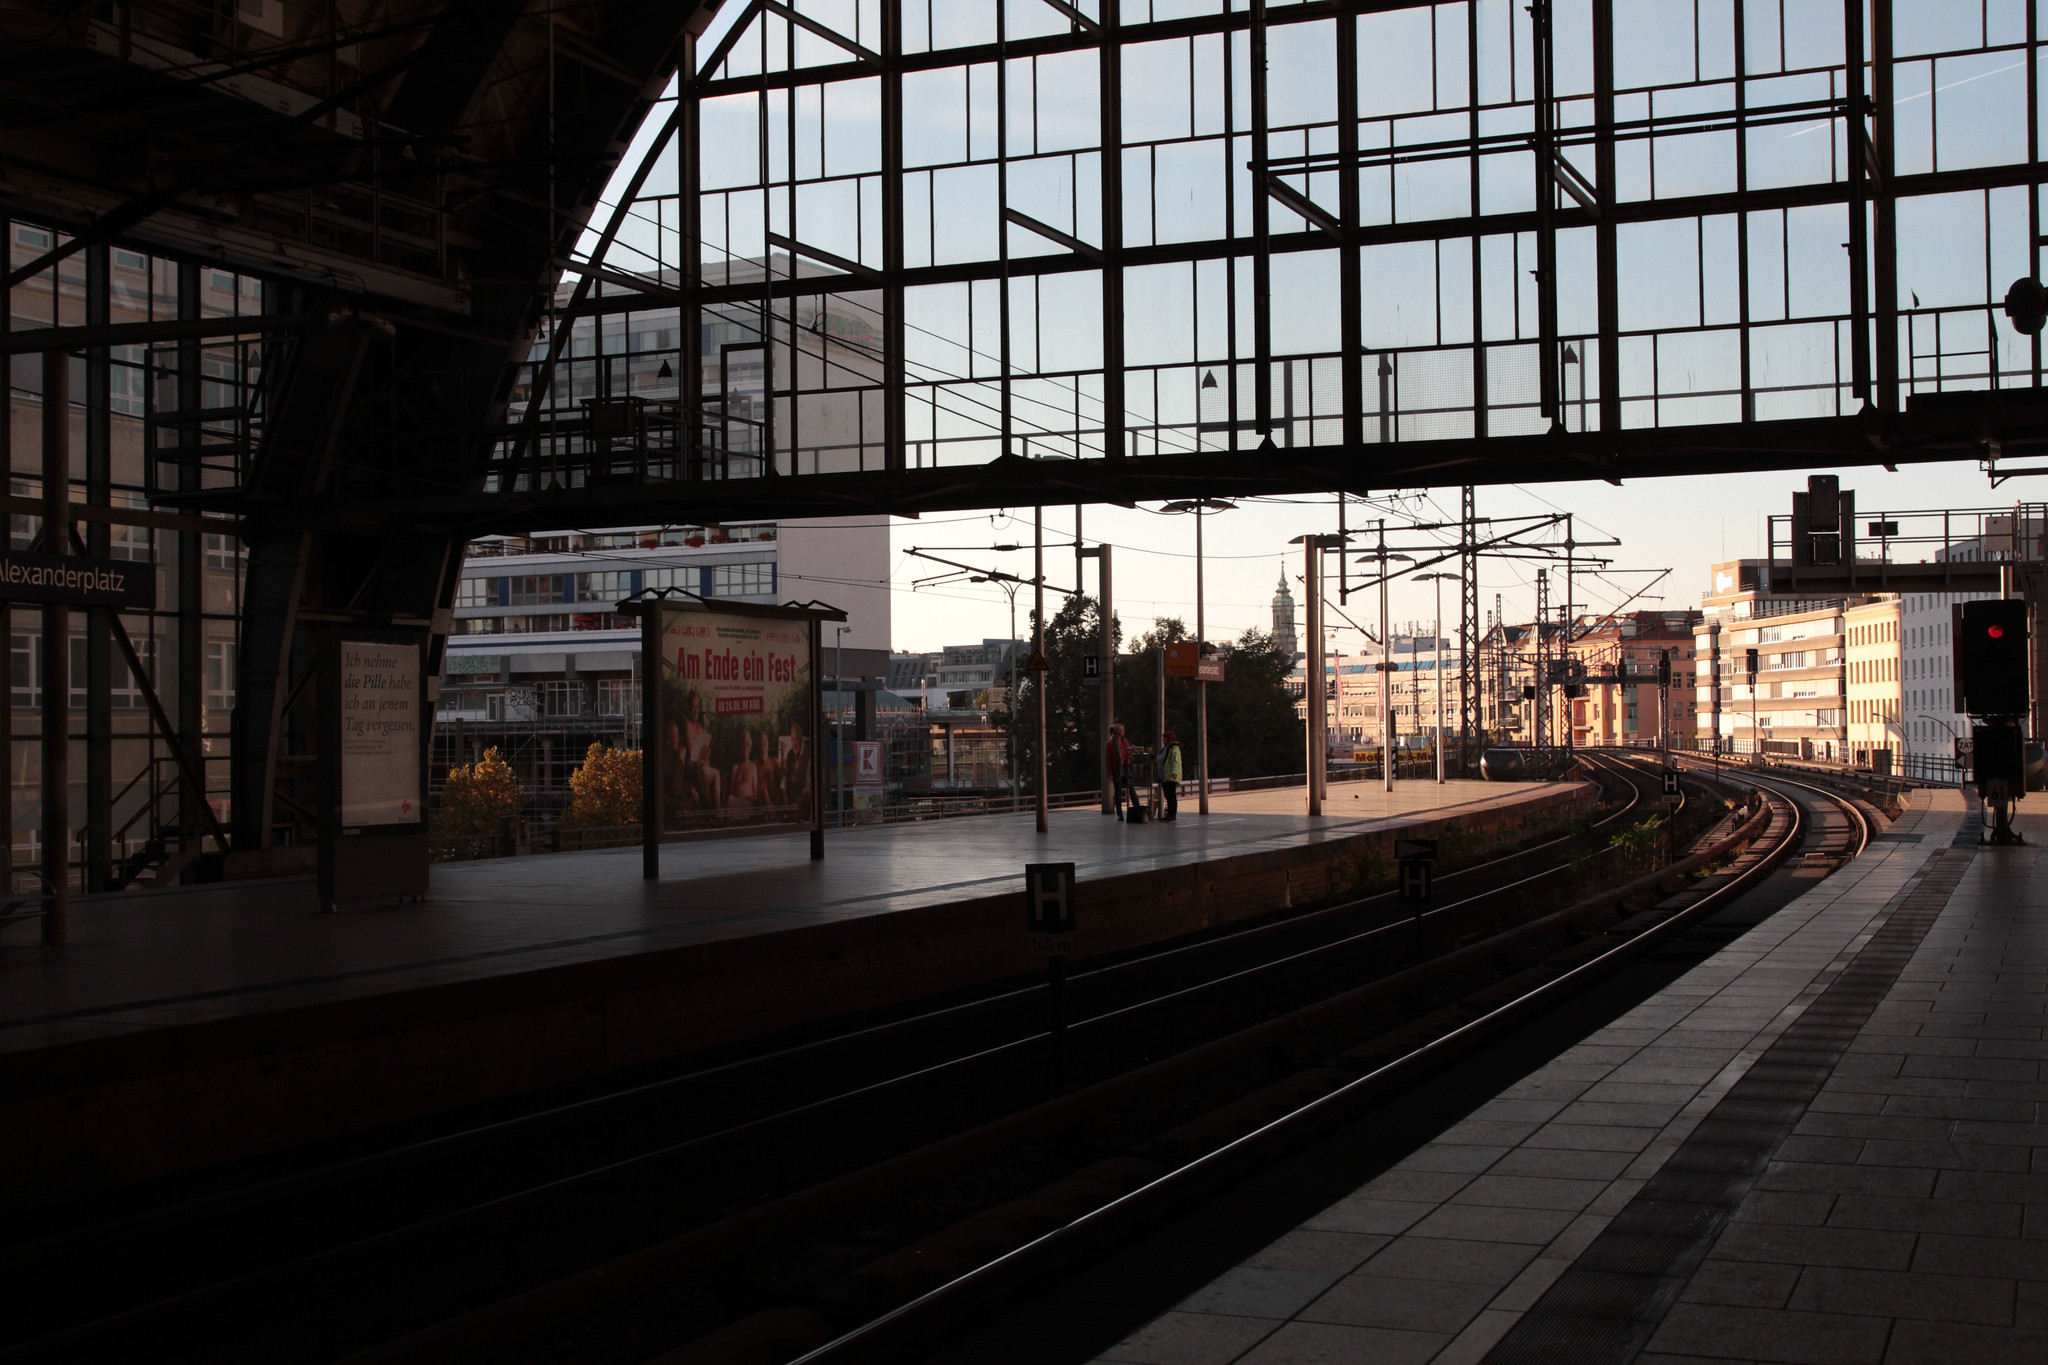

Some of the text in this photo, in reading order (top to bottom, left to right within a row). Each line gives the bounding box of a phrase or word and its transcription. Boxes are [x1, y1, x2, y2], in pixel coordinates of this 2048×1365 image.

[345, 652, 398, 669] Ich nehme
[677, 647, 797, 683] Am Ende ein Fest
[1086, 657, 1097, 675] H
[344, 673, 412, 690] die Pille habe
[344, 694, 409, 716] ich an jenem
[345, 716, 415, 737] Tag vergessen.
[1713, 747, 1721, 756] H
[1958, 741, 1974, 750] ZAT
[863, 749, 874, 770] K
[1664, 773, 1678, 792] H
[1991, 786, 2004, 801] 61
[1404, 866, 1426, 897] H
[1033, 872, 1068, 921] H
[1031, 937, 1072, 953] 140 m
